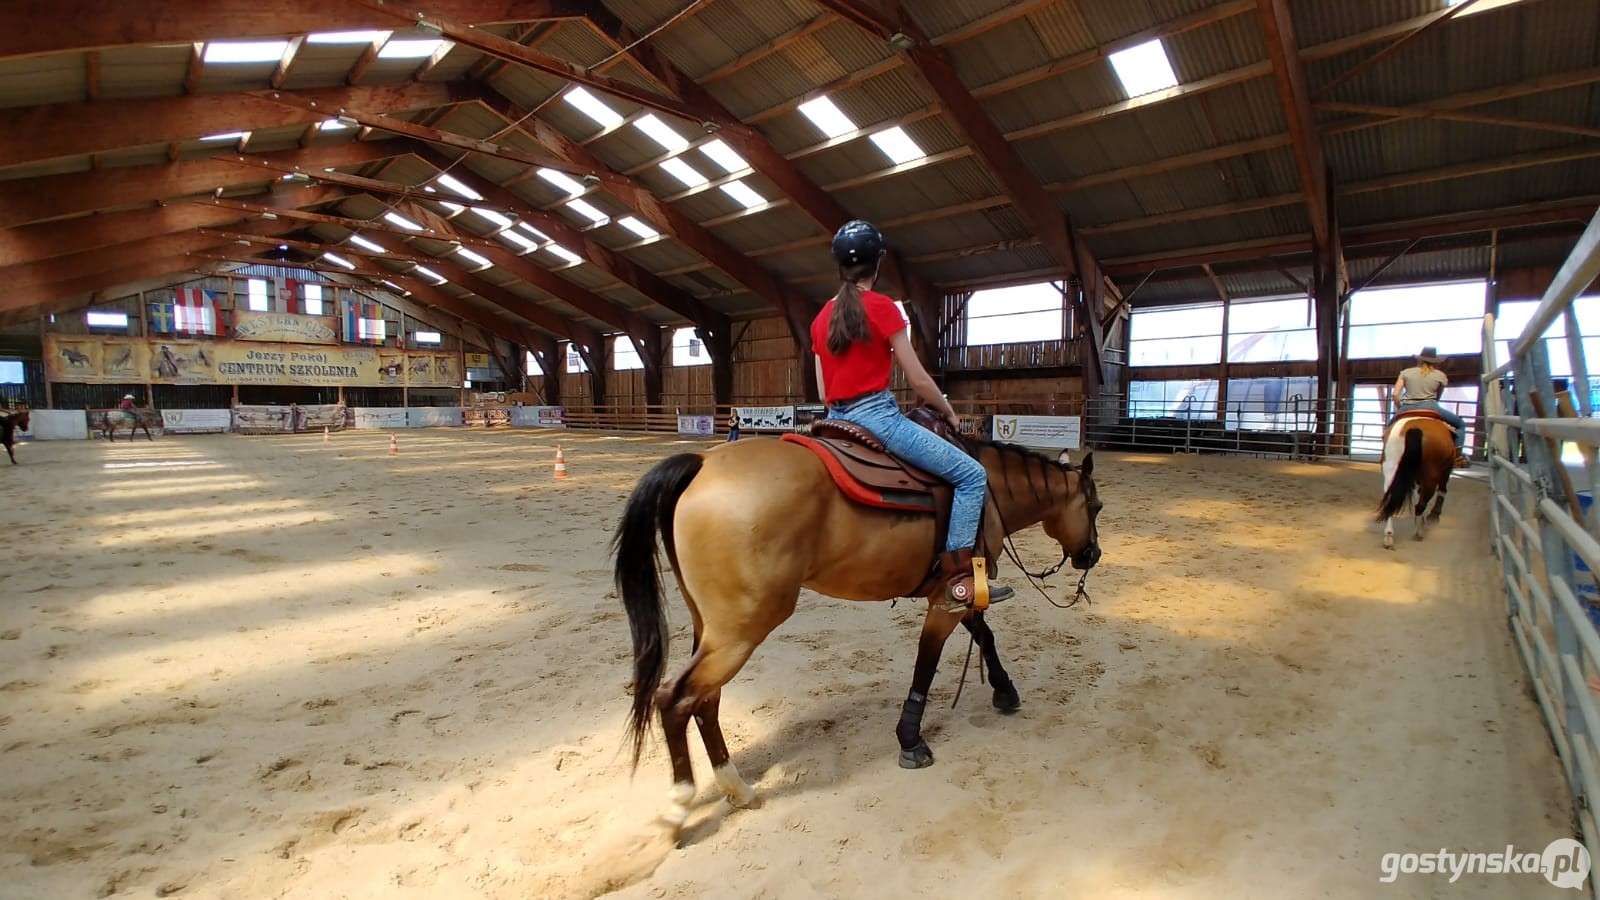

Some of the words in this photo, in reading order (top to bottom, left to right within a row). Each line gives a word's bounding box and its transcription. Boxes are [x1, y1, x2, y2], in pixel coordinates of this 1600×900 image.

[246, 351, 285, 362] Jerzy
[290, 352, 327, 364] Pokój
[218, 362, 285, 375] CENTRUM
[289, 364, 359, 378] SZKOLENIA
[1002, 424, 1010, 435] R
